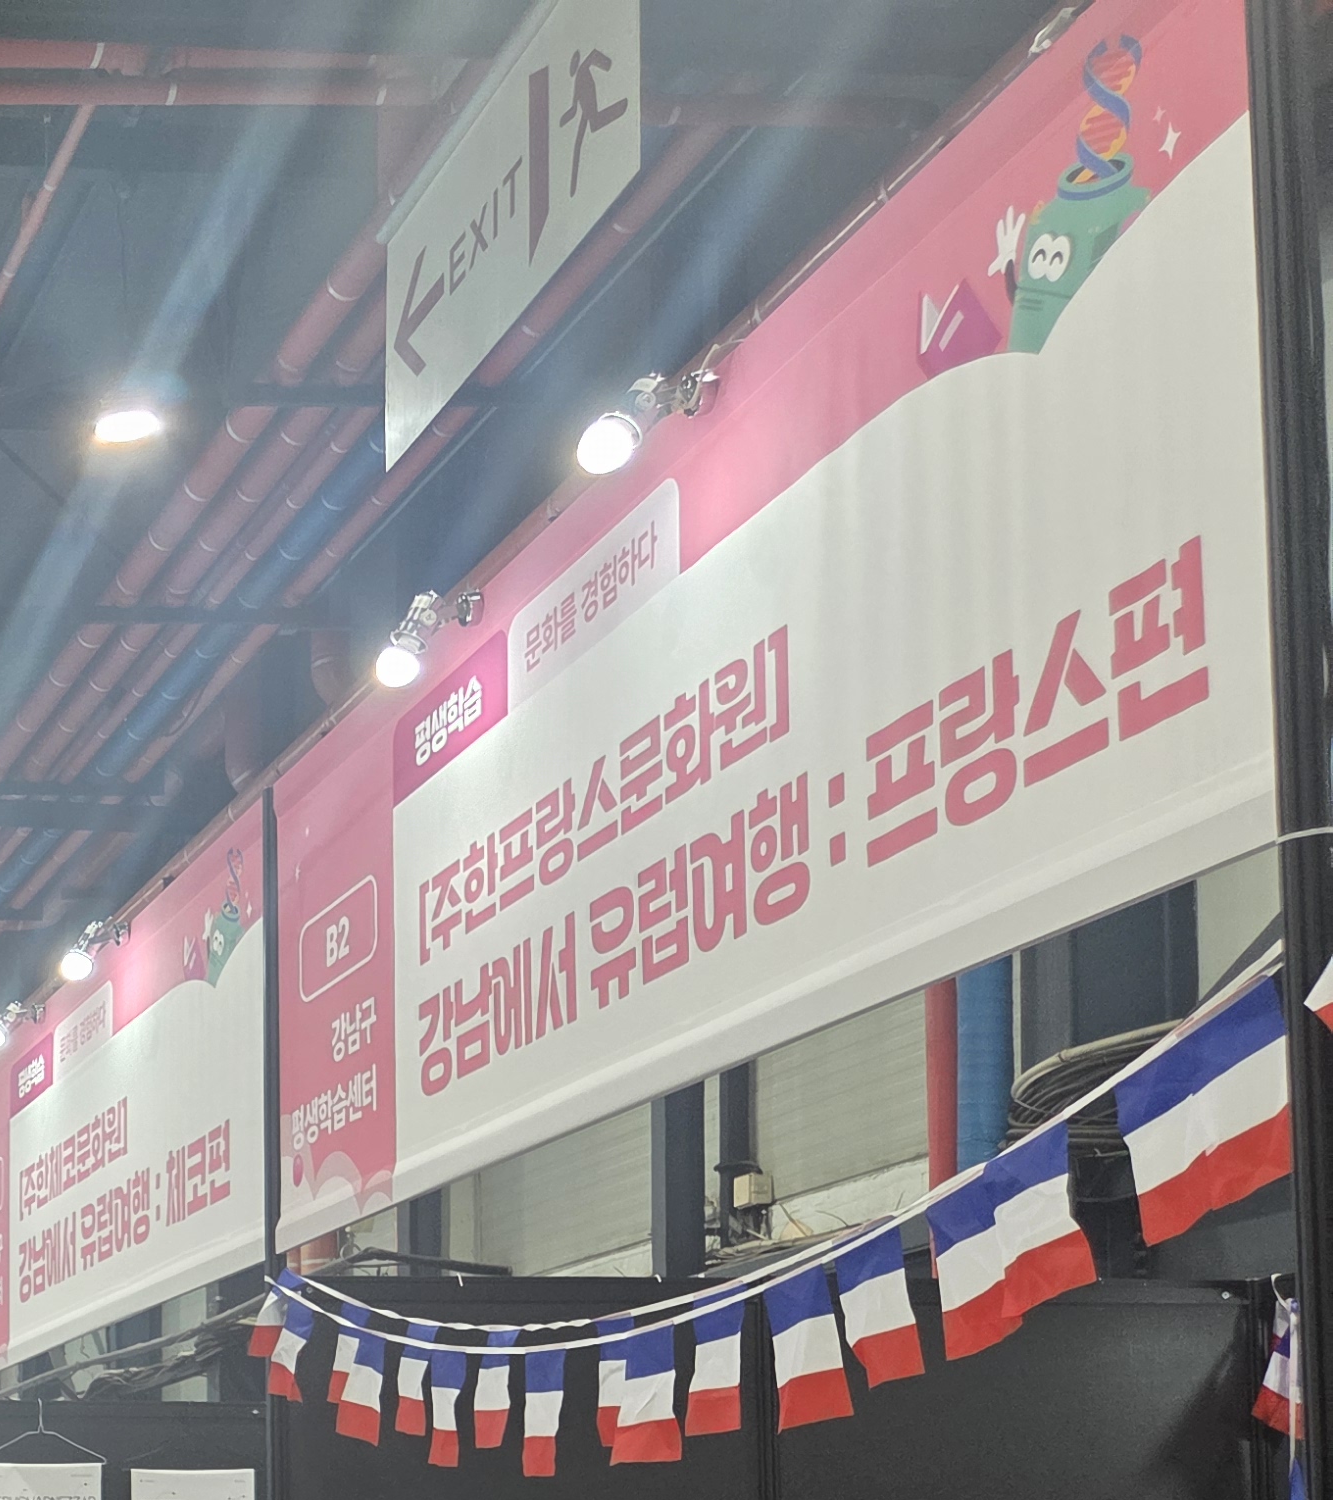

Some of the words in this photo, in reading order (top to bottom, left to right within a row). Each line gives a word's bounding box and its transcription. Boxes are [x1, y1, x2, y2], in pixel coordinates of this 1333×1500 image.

[449, 154, 523, 296] EXIT
[524, 596, 578, 674] 문화를
[580, 520, 659, 627] 경험하다
[414, 674, 484, 767] 평생학습
[418, 624, 791, 966] [주한프랑스문화원]
[419, 911, 578, 1097] 강남에서
[589, 772, 812, 1011] 유럽여행
[865, 535, 1210, 868] 프랑스편
[325, 915, 352, 971] B2
[18, 1053, 46, 1098] 평생학습
[331, 996, 378, 1064] 강남구
[19, 1096, 128, 1221] [주한체코문화원]
[291, 1063, 378, 1152] 평생학습센터
[19, 1211, 76, 1303] 강남에서
[80, 1166, 151, 1271] 유럽여행
[165, 1118, 231, 1228] 체코편
